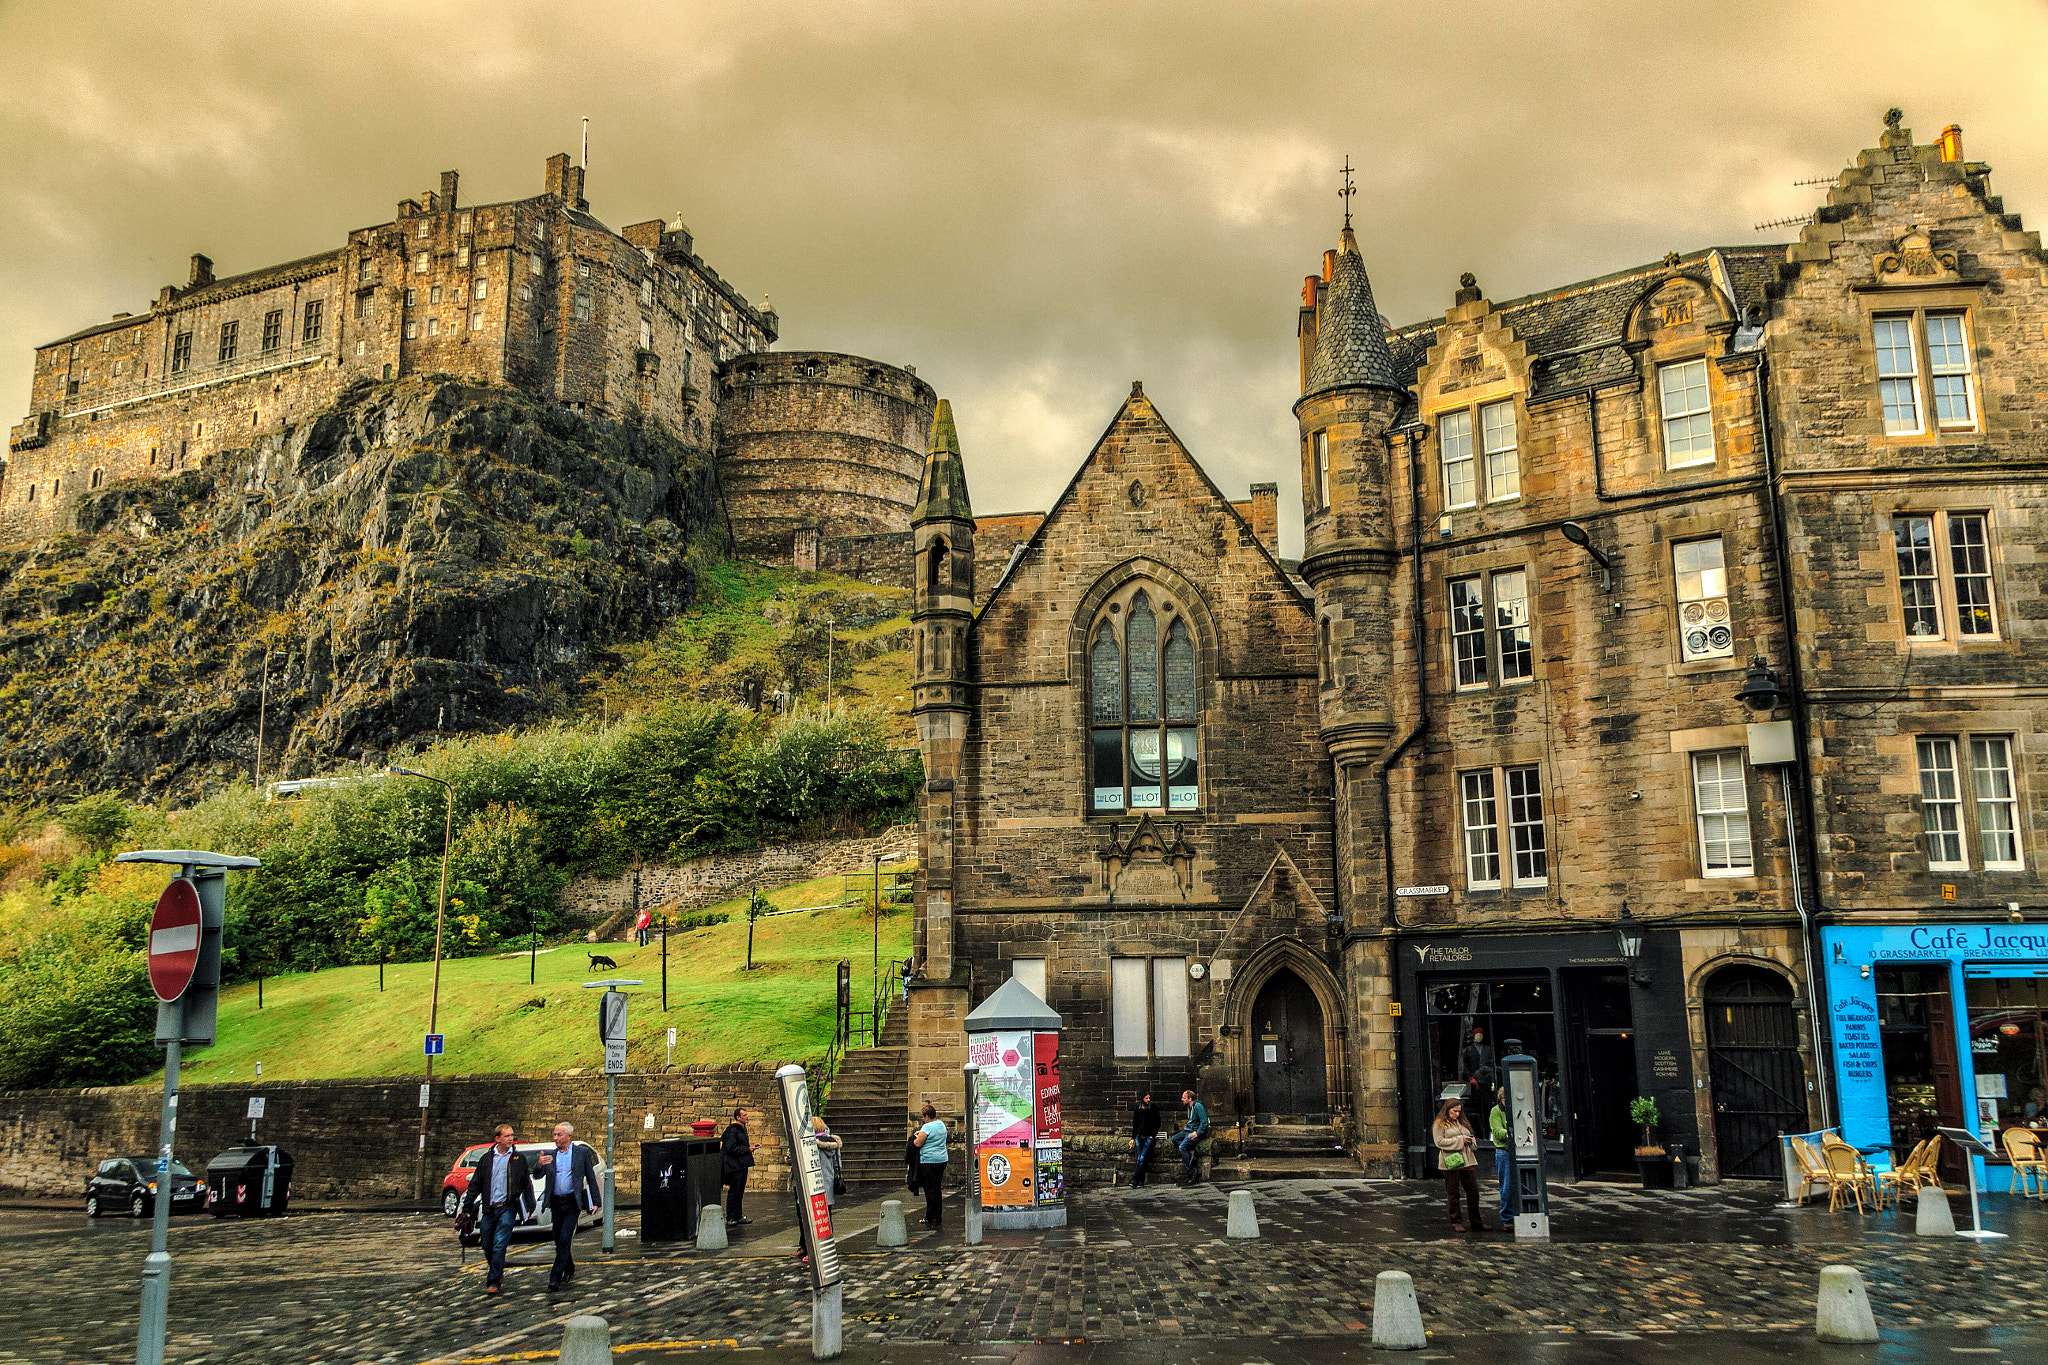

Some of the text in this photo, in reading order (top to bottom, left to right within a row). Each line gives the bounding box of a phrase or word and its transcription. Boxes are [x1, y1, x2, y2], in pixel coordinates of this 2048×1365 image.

[1105, 794, 1121, 802] LOT
[1142, 793, 1159, 801] LOT
[1180, 793, 1196, 801] LOT
[1398, 886, 1446, 895] GRASSMARKET
[1978, 927, 2048, 951] Jacqu
[1430, 946, 1469, 955] THE TAILOR
[1868, 950, 1877, 958] 10
[1880, 949, 1948, 958] GRASSMARKET
[1964, 948, 2022, 957] BREAKFASTS
[1429, 953, 1472, 962] RETAILORED
[1850, 996, 1874, 1013] Jacques
[1264, 1020, 1272, 1031] 4
[971, 1042, 999, 1056] PLEASANCE
[971, 1052, 1000, 1066] SESSIONS
[608, 1060, 623, 1069] ENDS
[1043, 1104, 1058, 1116] FILM
[1037, 1148, 1062, 1161] LIMBO
